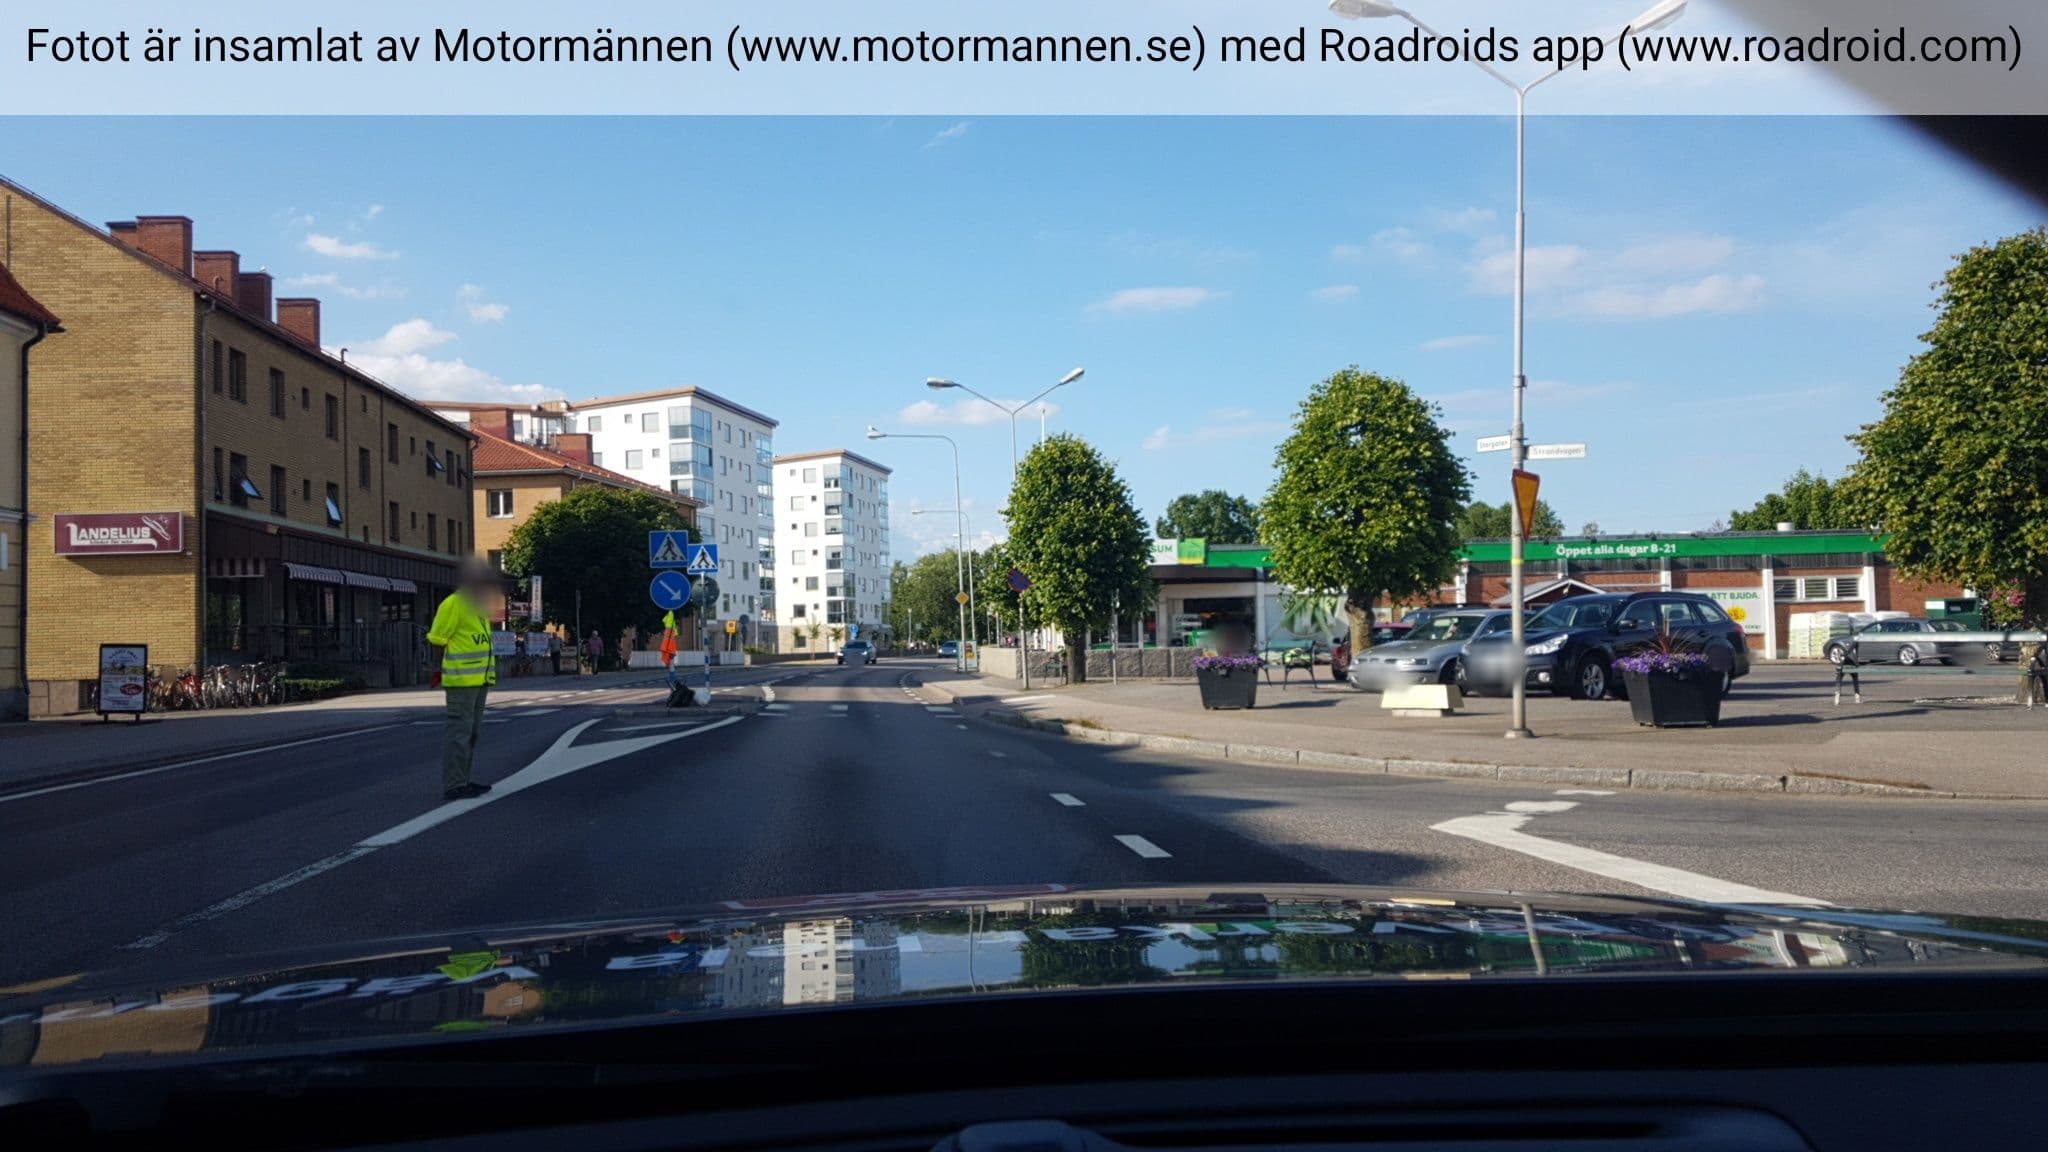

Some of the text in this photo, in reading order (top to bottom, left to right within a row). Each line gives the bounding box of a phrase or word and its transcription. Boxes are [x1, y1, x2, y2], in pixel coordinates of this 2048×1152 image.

[65, 523, 154, 547] LANDELIUS
[1556, 543, 1676, 557] Öppet alla dagar 8-21
